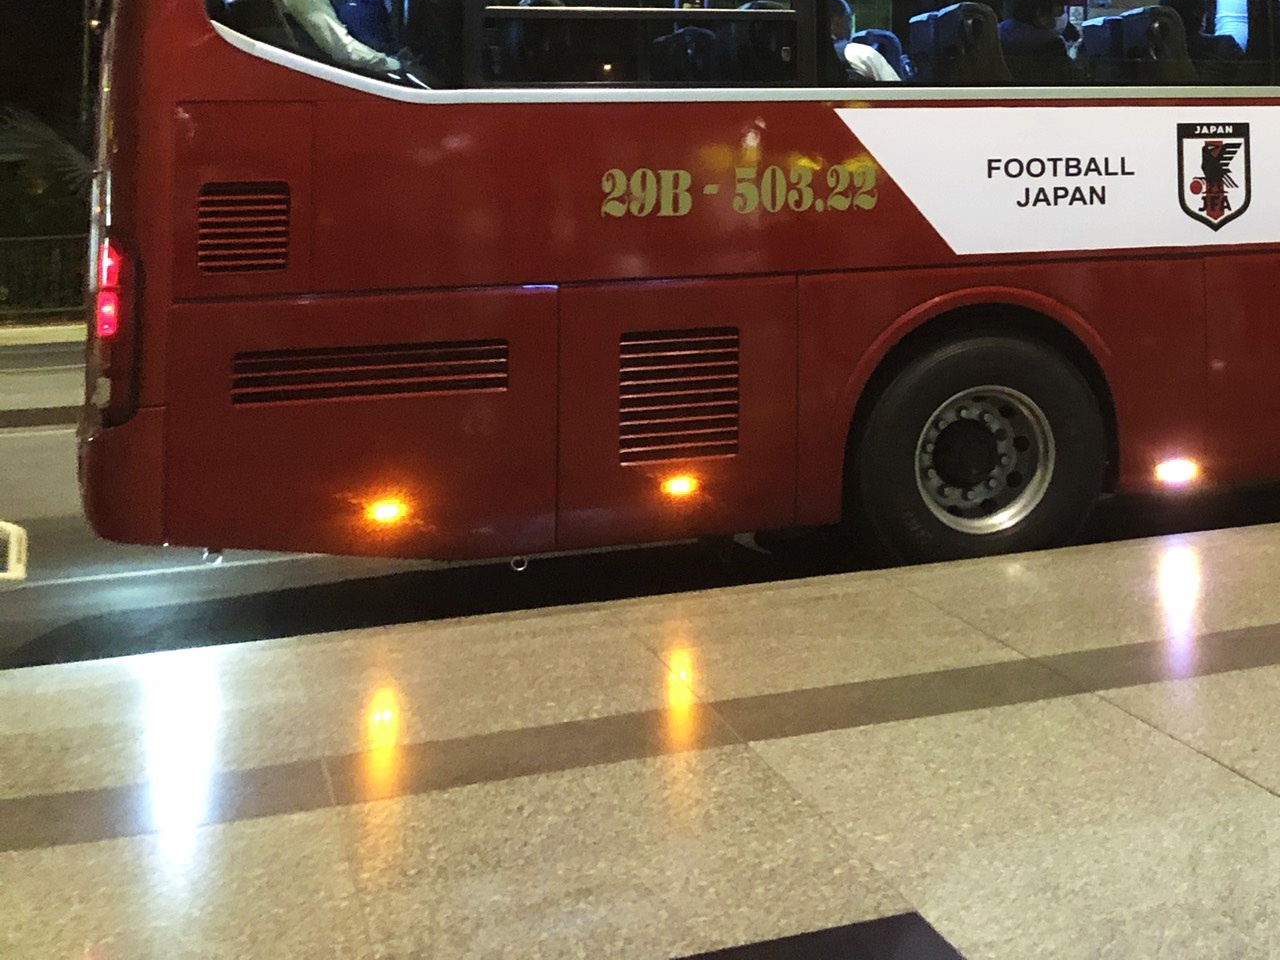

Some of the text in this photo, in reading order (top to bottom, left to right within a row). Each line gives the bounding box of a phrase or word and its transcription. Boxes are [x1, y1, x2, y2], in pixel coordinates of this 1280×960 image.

[1194, 125, 1233, 134] JAPAN
[986, 156, 1135, 180] FOOTBALL
[600, 168, 693, 218] 29B
[732, 165, 878, 214] 503.22
[1016, 184, 1107, 207] JAPAN
